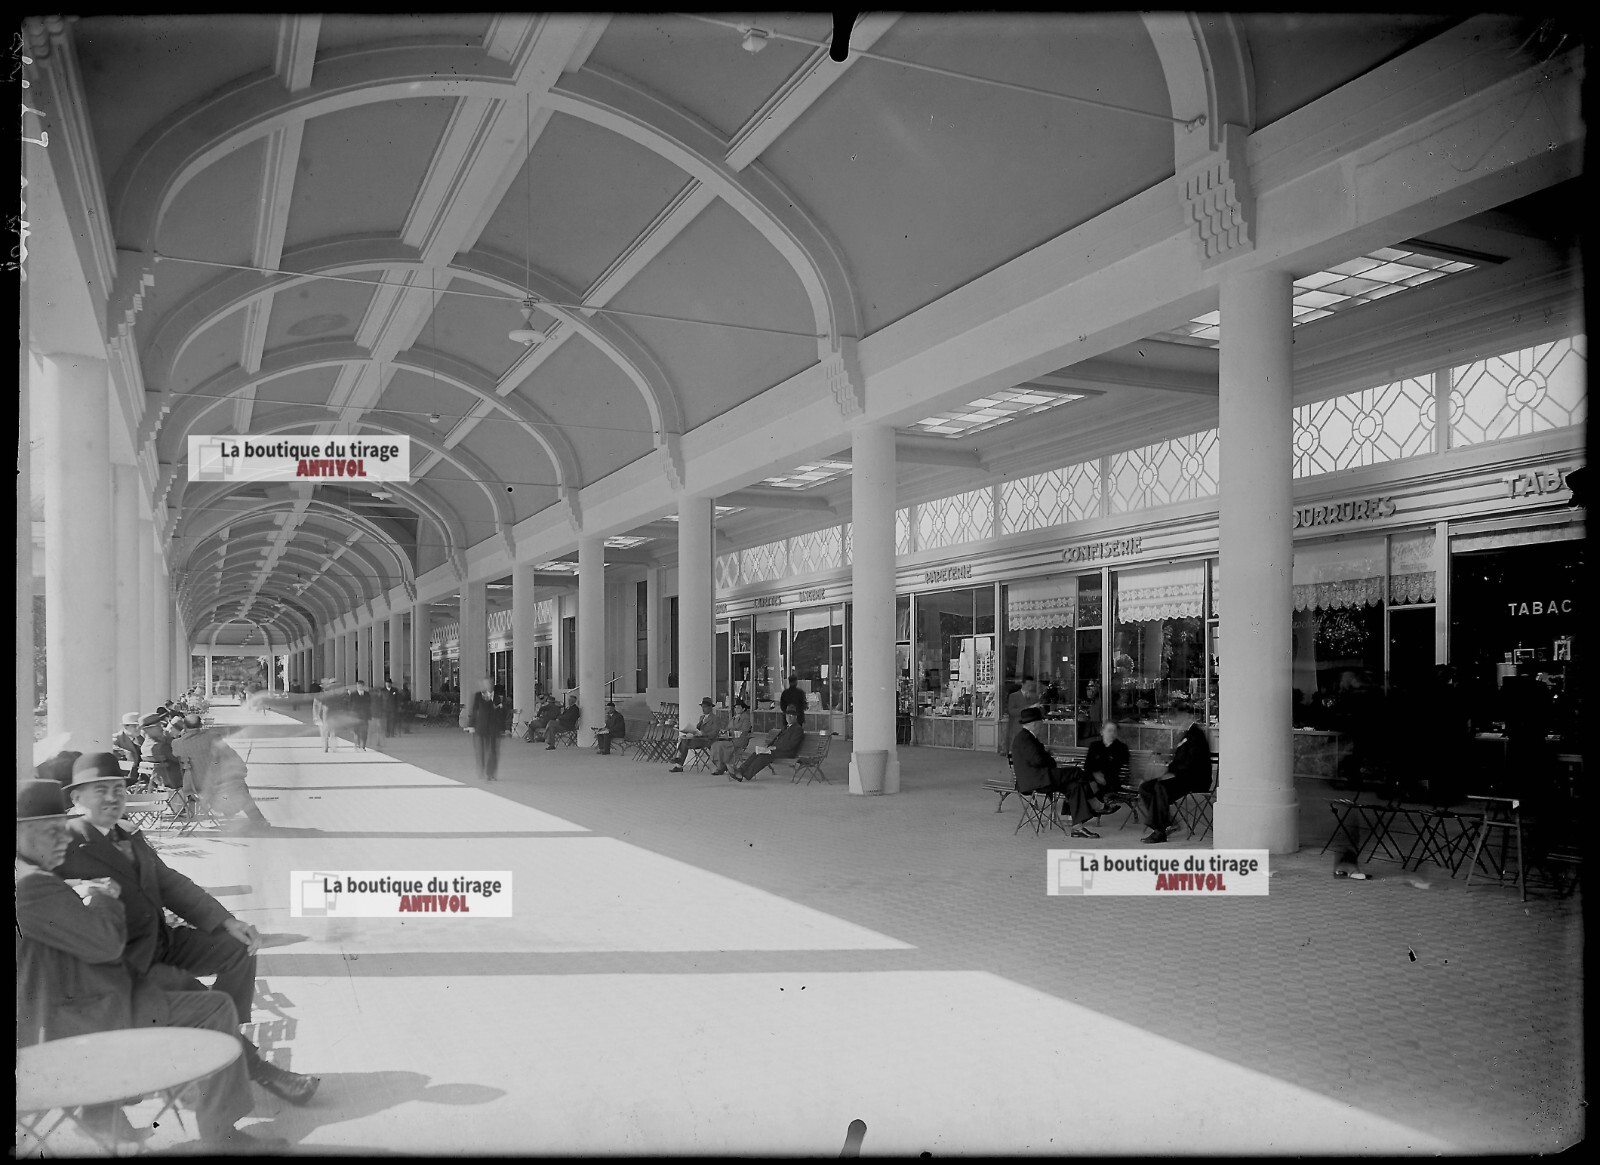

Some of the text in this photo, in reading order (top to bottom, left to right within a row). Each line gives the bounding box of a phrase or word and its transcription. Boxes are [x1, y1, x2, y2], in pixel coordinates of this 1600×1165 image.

[1062, 537, 1143, 562] CONFISERIE
[925, 564, 972, 584] PAPETERIE
[1507, 599, 1573, 616] TABAC
